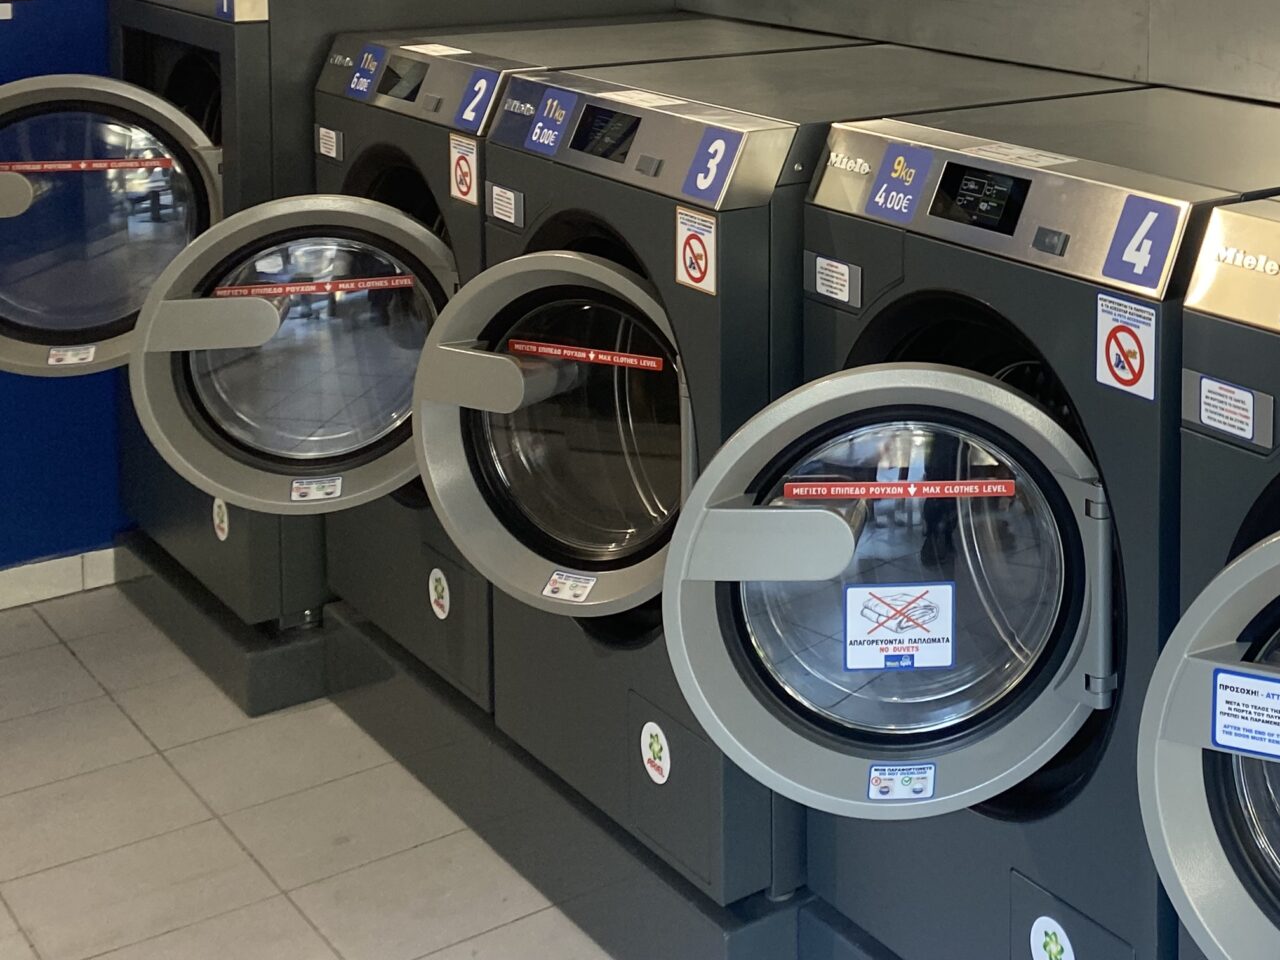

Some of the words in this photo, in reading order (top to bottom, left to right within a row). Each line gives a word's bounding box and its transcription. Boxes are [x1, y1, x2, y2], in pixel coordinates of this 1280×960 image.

[462, 78, 487, 122] 2
[543, 98, 566, 125] 11kg
[696, 138, 726, 190] 3
[891, 156, 916, 186] 9kg
[1121, 210, 1159, 275] 4
[1214, 246, 1280, 276] Miele
[792, 487, 828, 495] ΜΕΓΙΣΤΟ
[830, 486, 866, 495] ΕΠΙΠΕΔΟ
[869, 486, 904, 494] ΡΟΥΧΩΝ
[944, 485, 979, 494] CLOTHES
[982, 484, 1007, 493] LEVEL
[848, 638, 904, 646] ΑΠΑΓΟΡΕΥΟΝΤΑΙ
[1219, 684, 1259, 696] ΠΡΟΣΟΧΗ!
